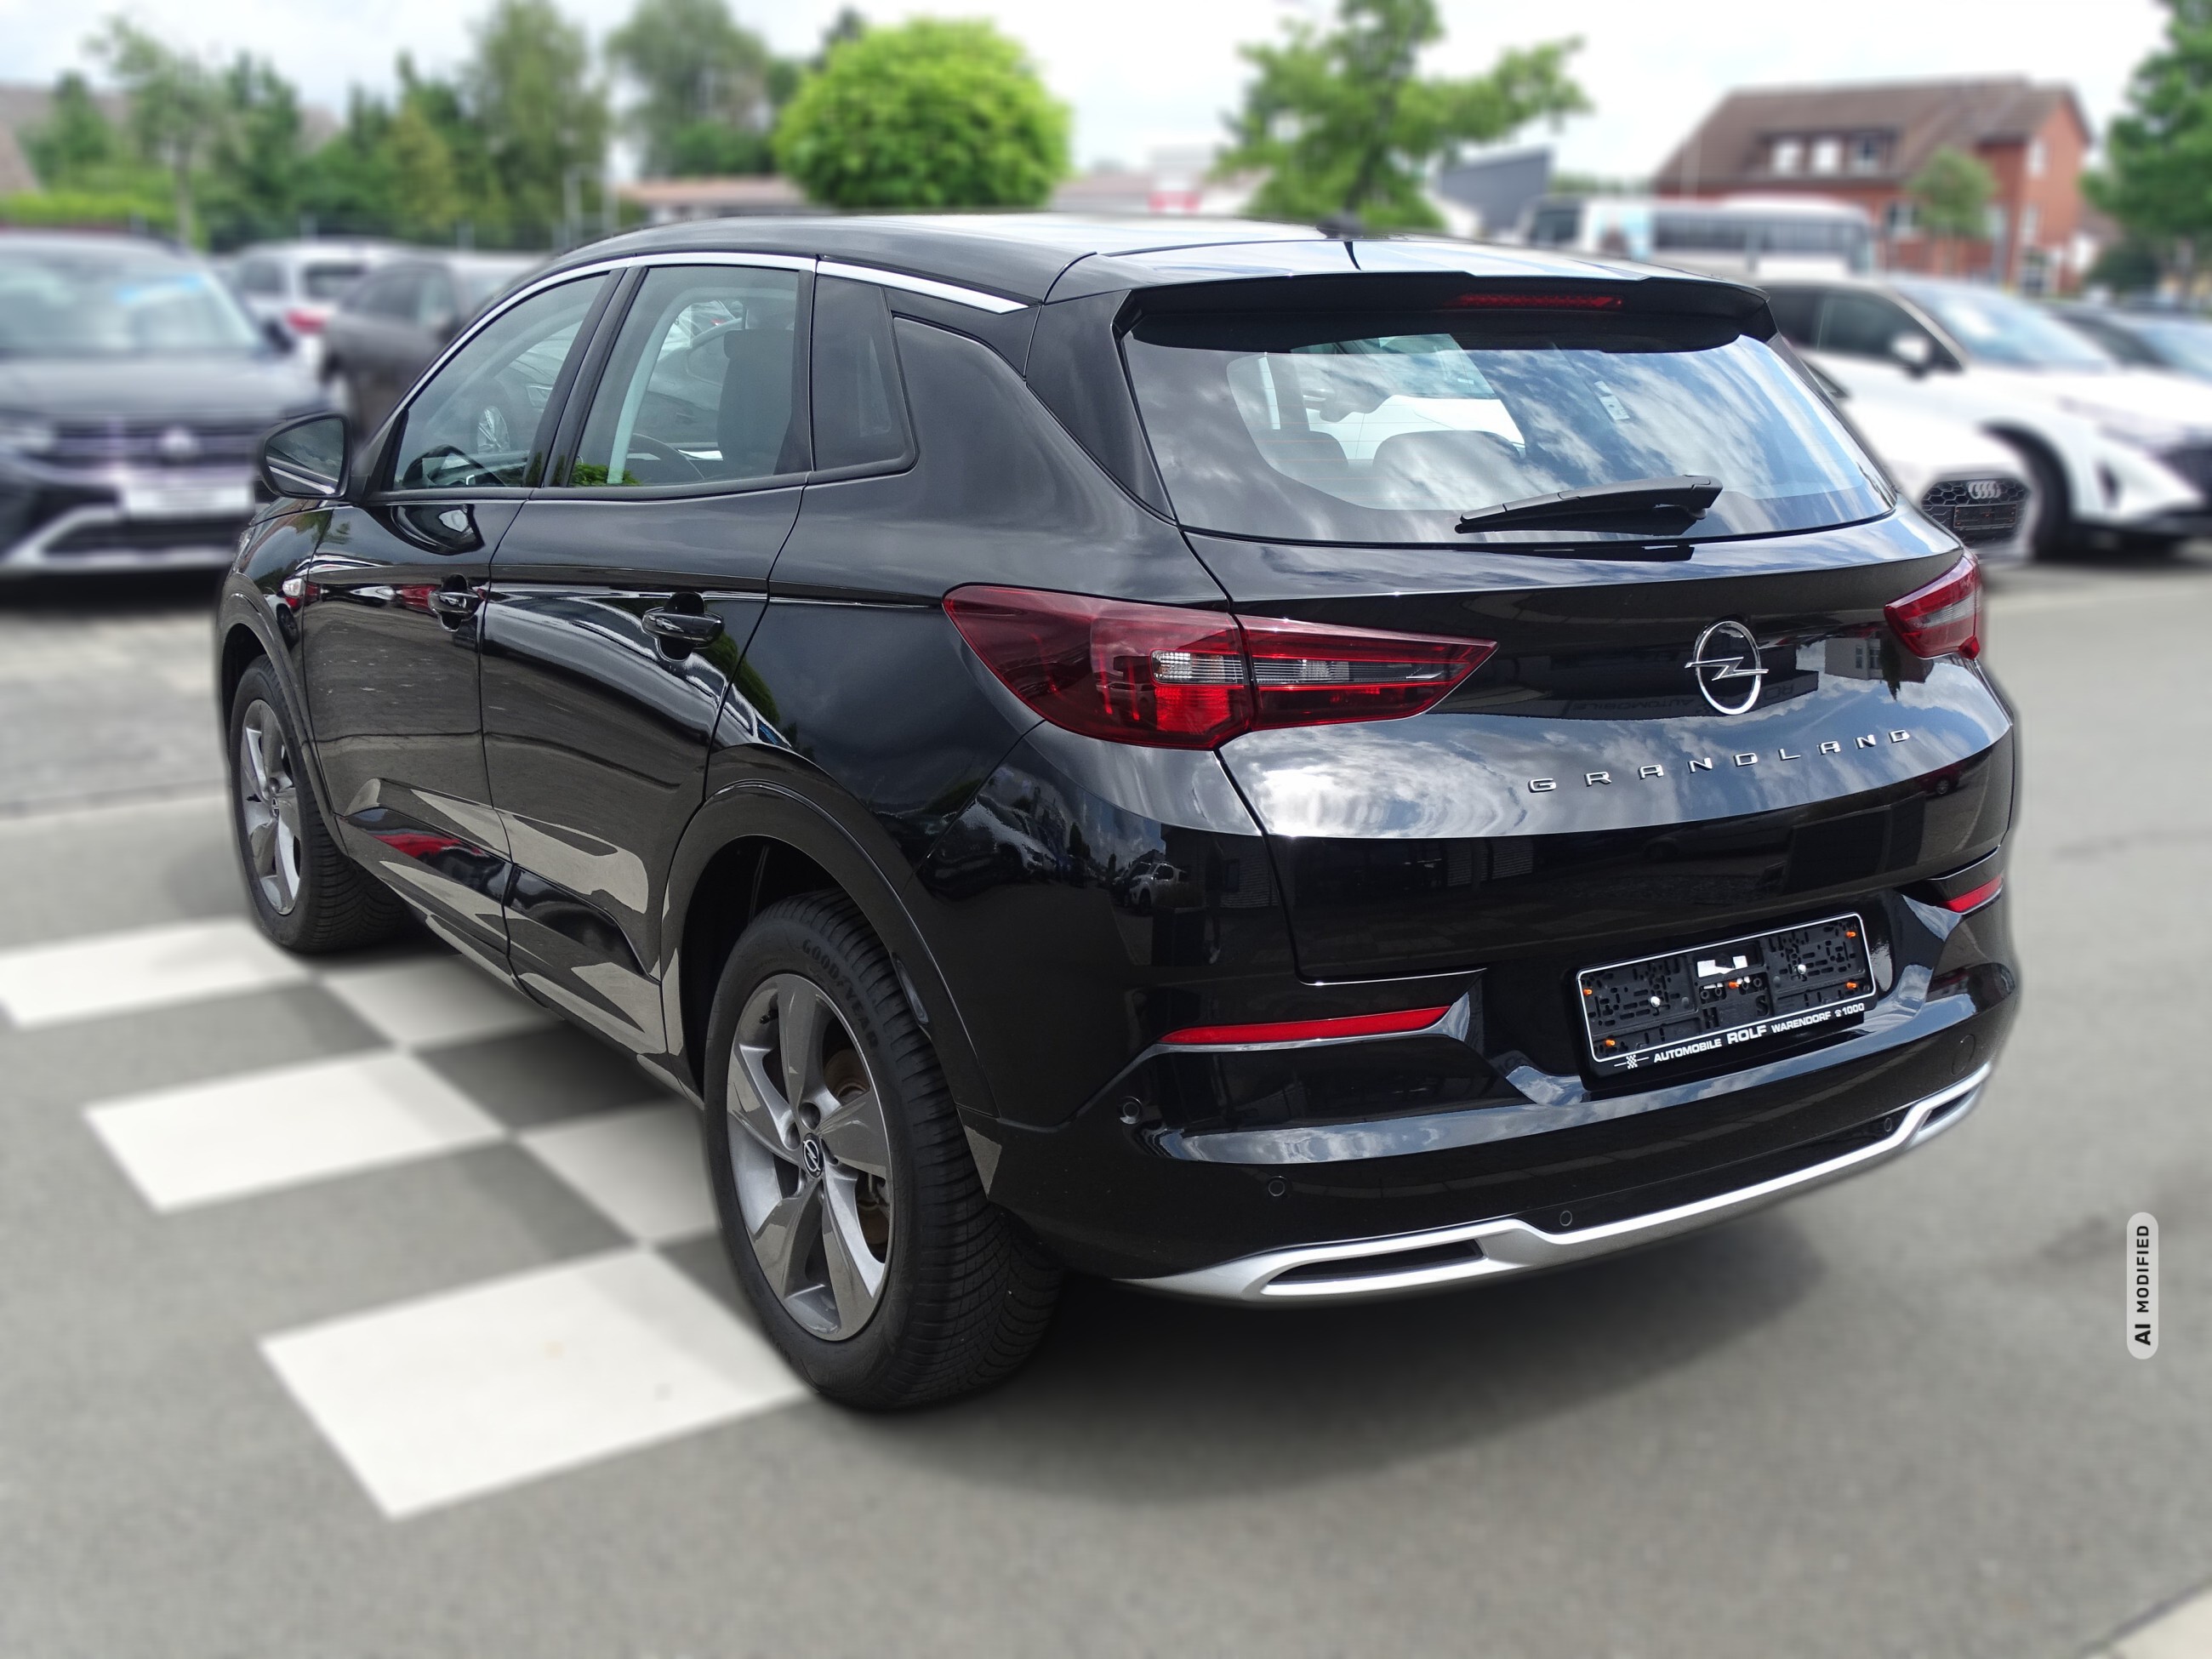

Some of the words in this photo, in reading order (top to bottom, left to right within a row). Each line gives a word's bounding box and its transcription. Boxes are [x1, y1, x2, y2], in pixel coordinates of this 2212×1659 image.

[1528, 729, 1911, 792] GRANDLAND
[802, 938, 879, 1049] GOODYEAR
[1653, 1038, 1723, 1063] AUTOMOBILE
[1726, 1024, 1767, 1045] ROLF
[1770, 1011, 1832, 1034] WARENDORF
